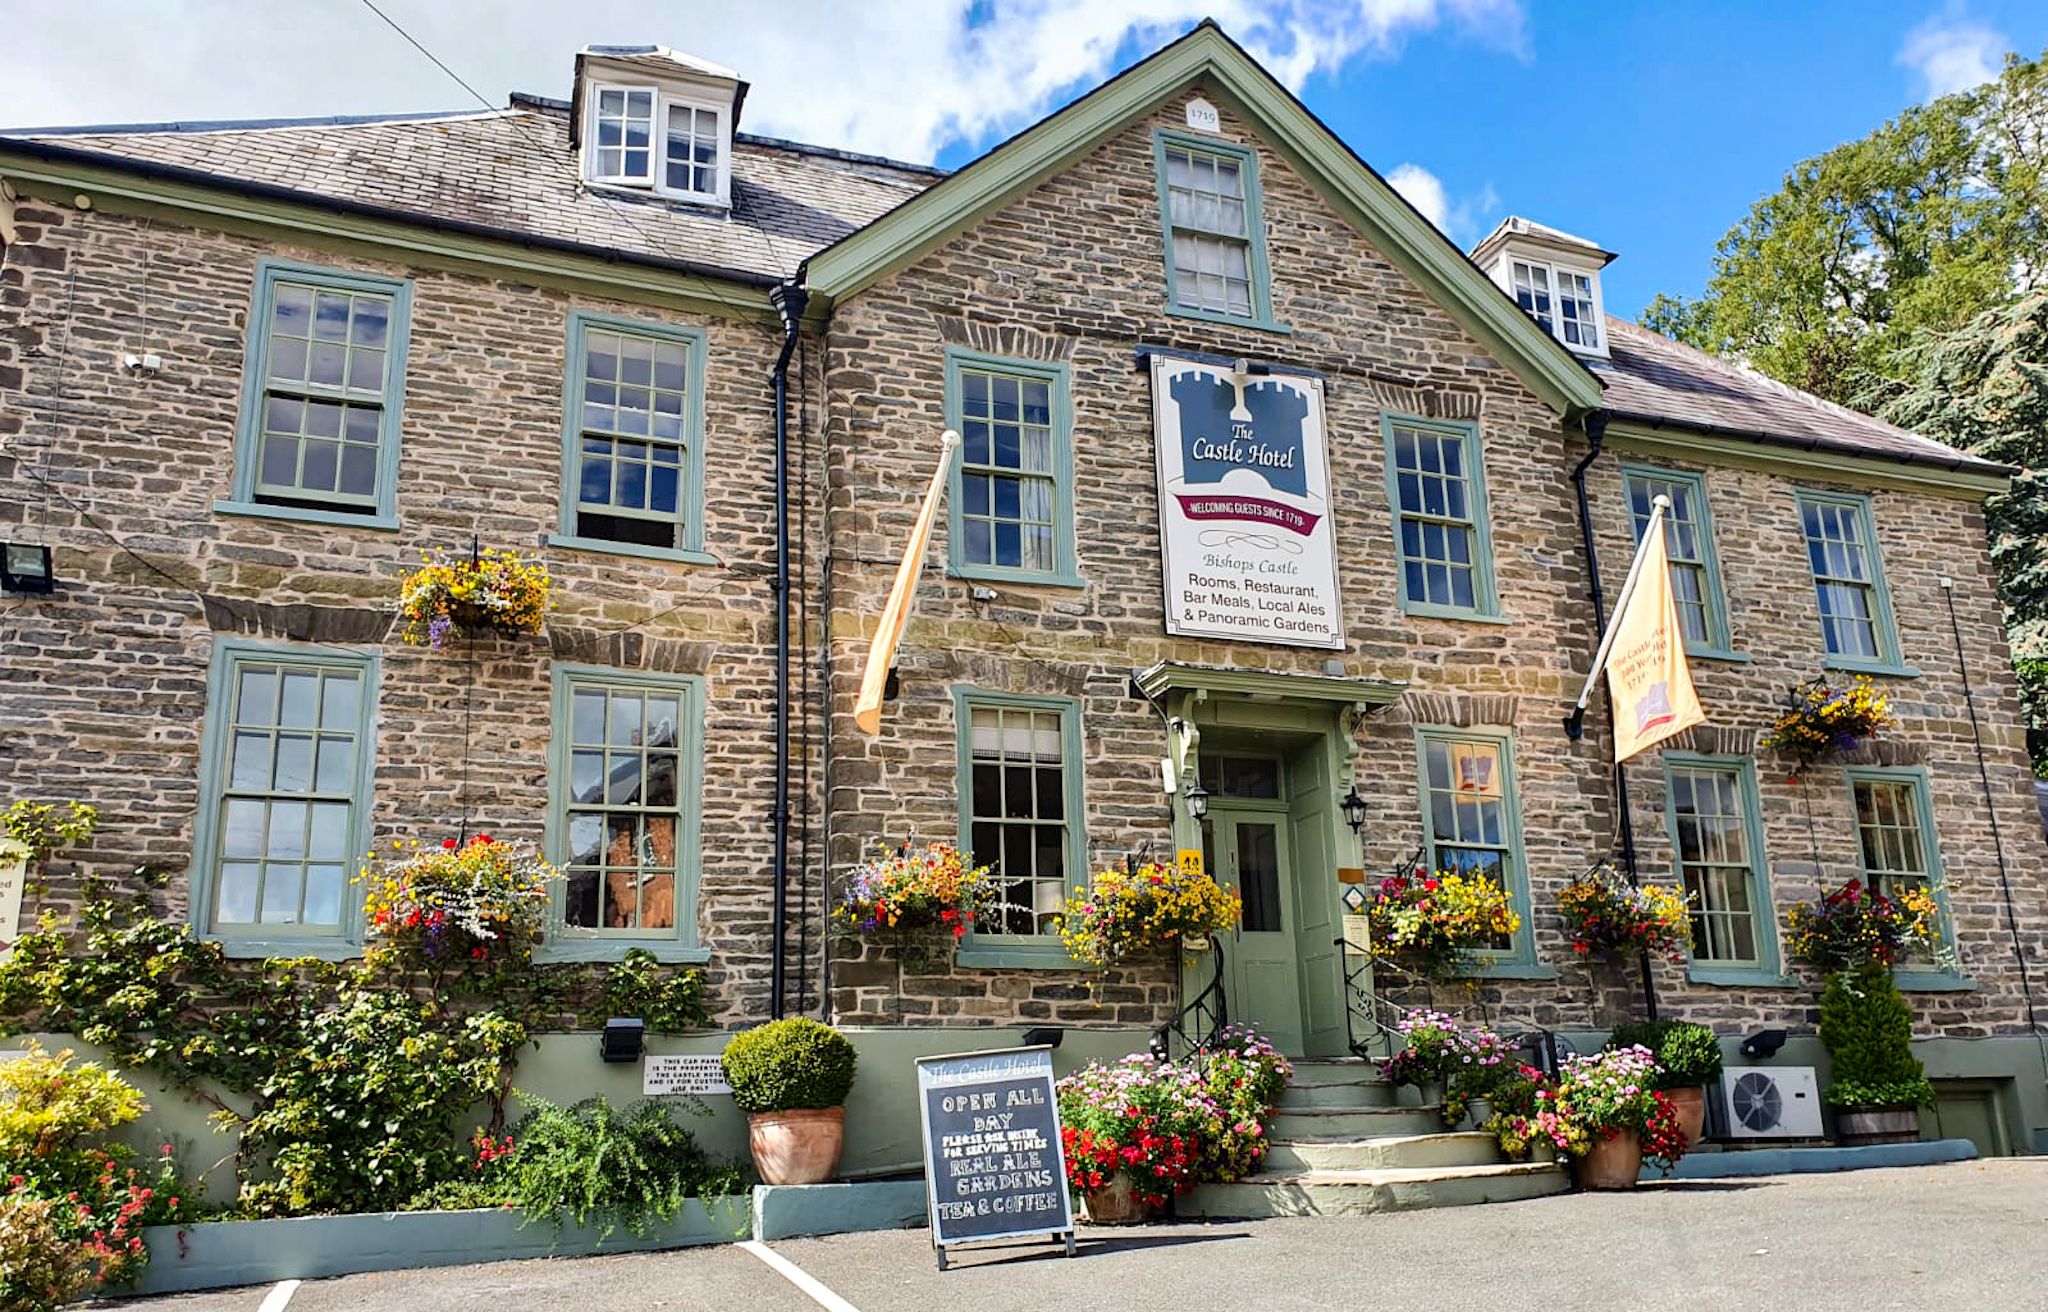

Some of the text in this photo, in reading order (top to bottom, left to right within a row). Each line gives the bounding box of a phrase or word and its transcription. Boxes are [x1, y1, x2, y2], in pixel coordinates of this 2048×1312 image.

[1192, 109, 1215, 123] 1719
[1231, 423, 1254, 440] The
[1192, 436, 1296, 469] Castle Hotel
[1234, 503, 1263, 516] GUESTS
[1263, 506, 1285, 521] SINCE
[1203, 553, 1299, 575] Bishops Castle
[1188, 573, 1319, 599] Rooms, Restaurant,
[1183, 590, 1326, 616] Bar Meals, Local Ales
[1183, 608, 1330, 634] & Panoramic Gardens
[930, 1053, 1044, 1085] The Castle Hotel
[942, 1087, 1045, 1113] OPEN ALL
[973, 1112, 1014, 1132] DAY
[942, 1128, 1039, 1148] PLEASE ASK INSIDE
[943, 1138, 1048, 1158] FOR SERVING TIMES
[950, 1151, 1041, 1177] REAL ALE
[956, 1169, 1054, 1196] GARDENS
[938, 1191, 1057, 1220] TEA & COFFEE
